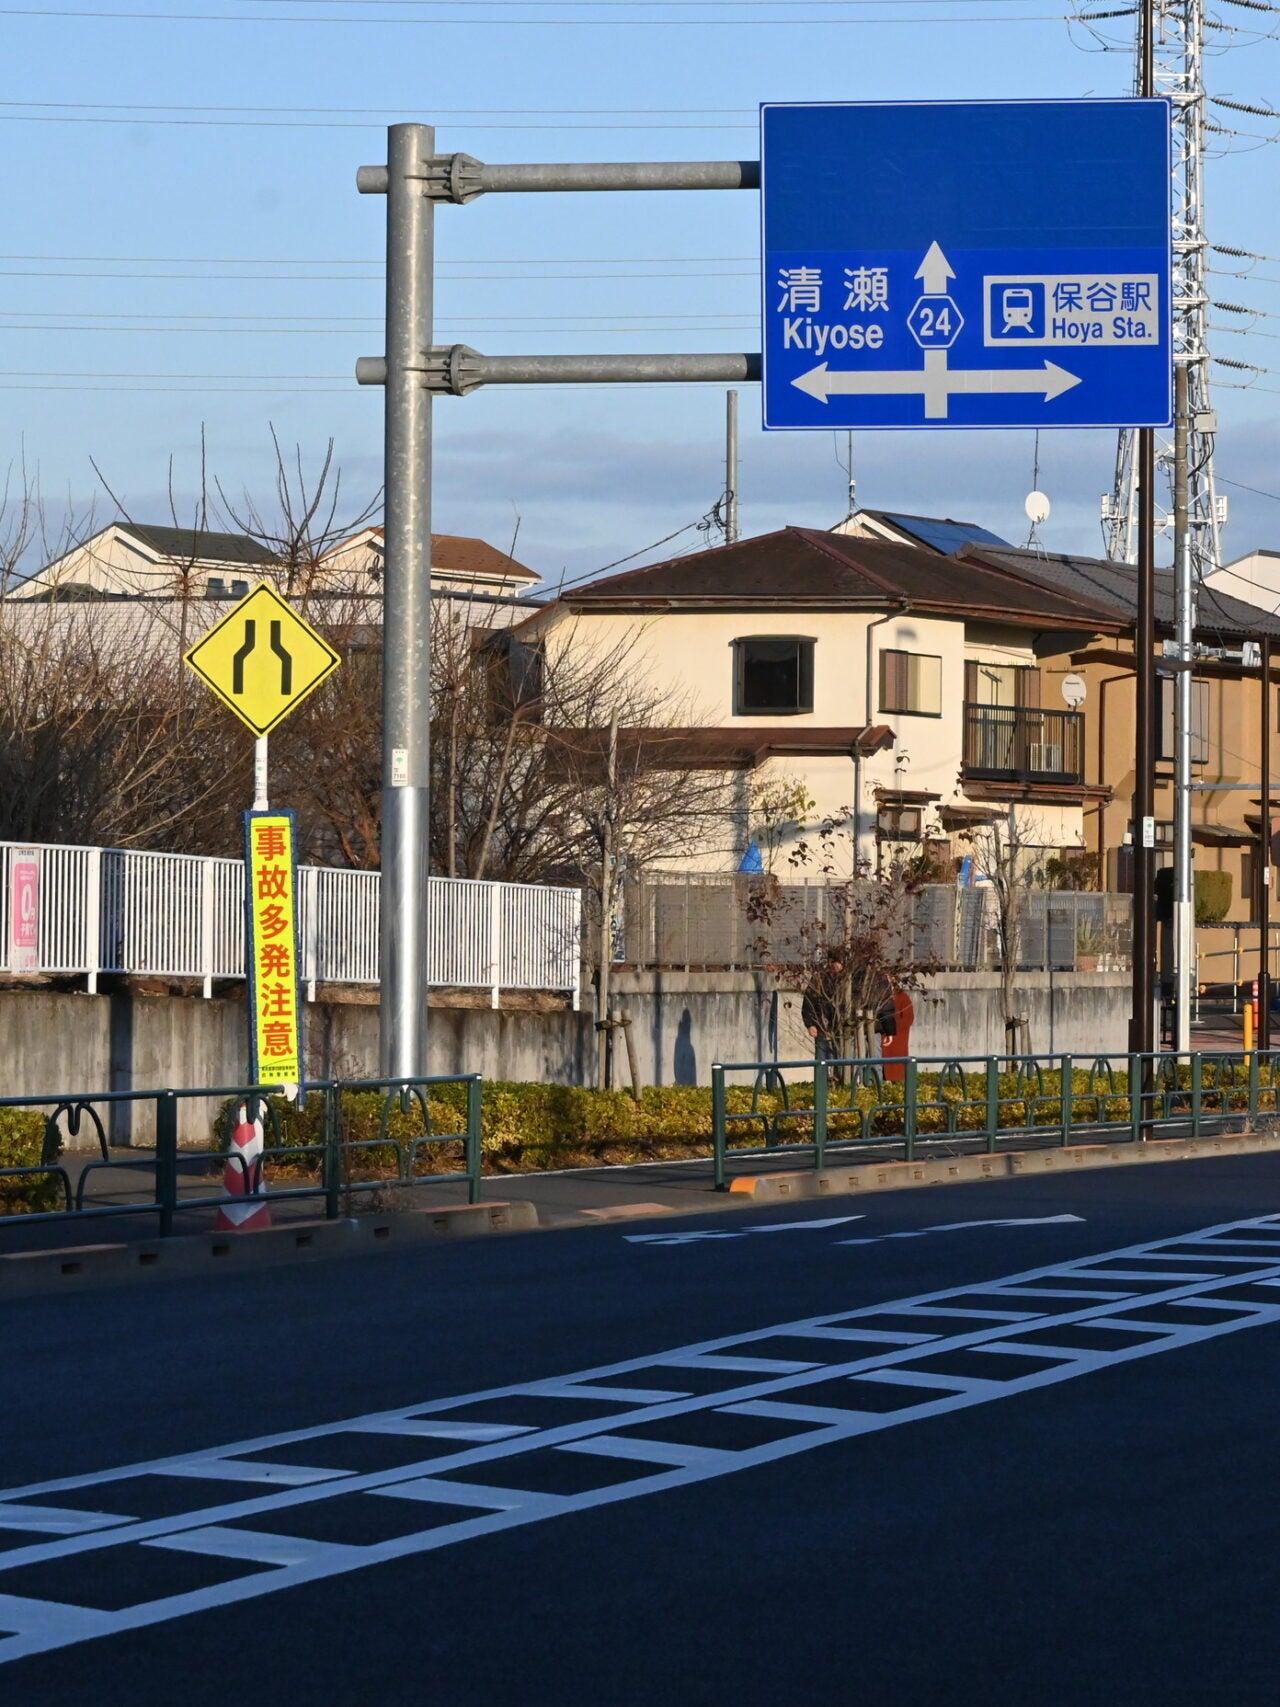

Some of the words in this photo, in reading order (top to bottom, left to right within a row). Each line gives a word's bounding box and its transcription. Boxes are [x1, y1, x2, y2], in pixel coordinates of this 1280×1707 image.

[777, 265, 889, 313] 清瀬
[1052, 281, 1152, 313] 保谷駅
[783, 316, 884, 356] Kiyose
[919, 307, 951, 337] 24
[1052, 317, 1103, 343] Hoya
[1112, 317, 1152, 339] Sta.
[254, 825, 294, 1057] 事故多発注意
